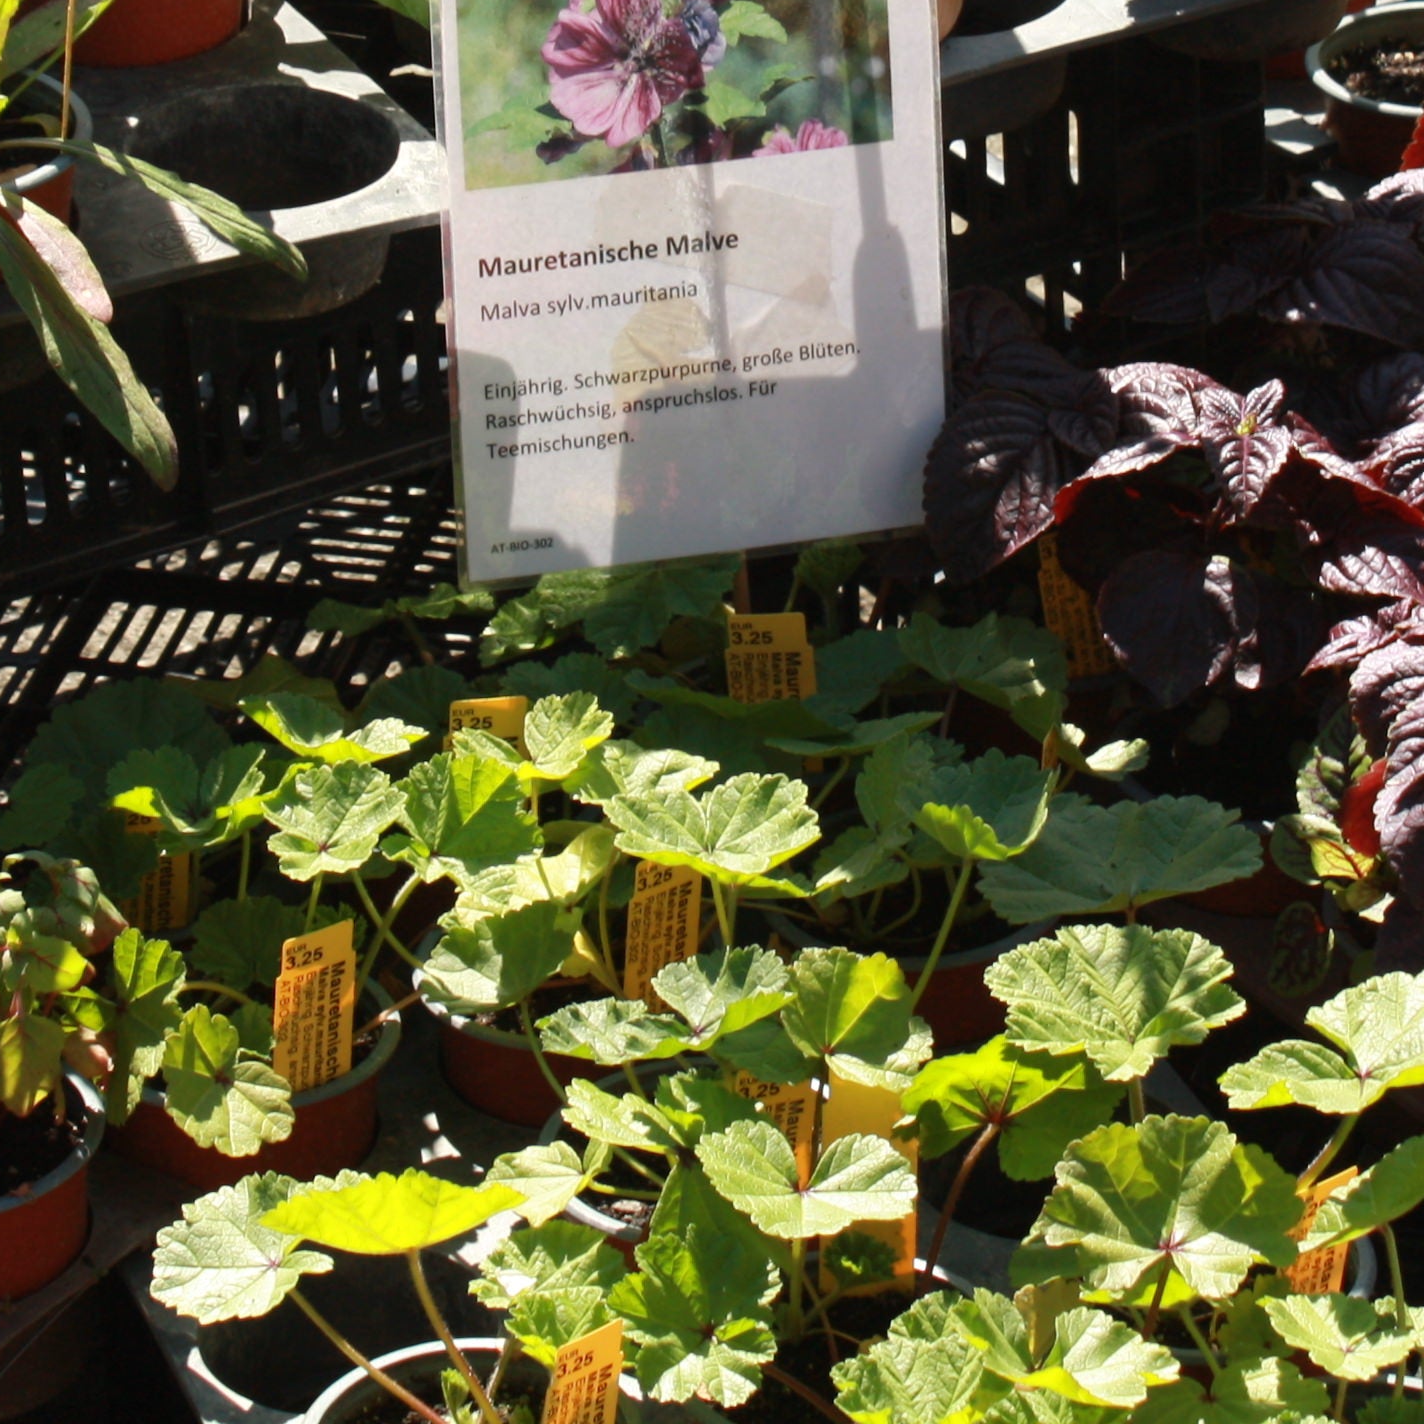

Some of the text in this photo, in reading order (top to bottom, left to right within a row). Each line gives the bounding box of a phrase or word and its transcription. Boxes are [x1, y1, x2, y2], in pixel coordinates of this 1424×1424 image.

[478, 231, 739, 277] Mauretanische Malve
[480, 281, 698, 322] Malva sylv.mauritania
[484, 340, 861, 401] Einjährig. Schwarzpurpurne, große Blüten.
[486, 381, 777, 430] Raschwüchsig, anspruchslos. Für
[486, 429, 634, 459] Teemischungen.
[491, 538, 553, 554] AT-BIO-302
[732, 631, 773, 645] 3.25
[452, 716, 493, 730] 325
[637, 868, 672, 892] 3.25
[285, 947, 324, 970] 3.25
[558, 1351, 593, 1379] 3.25
